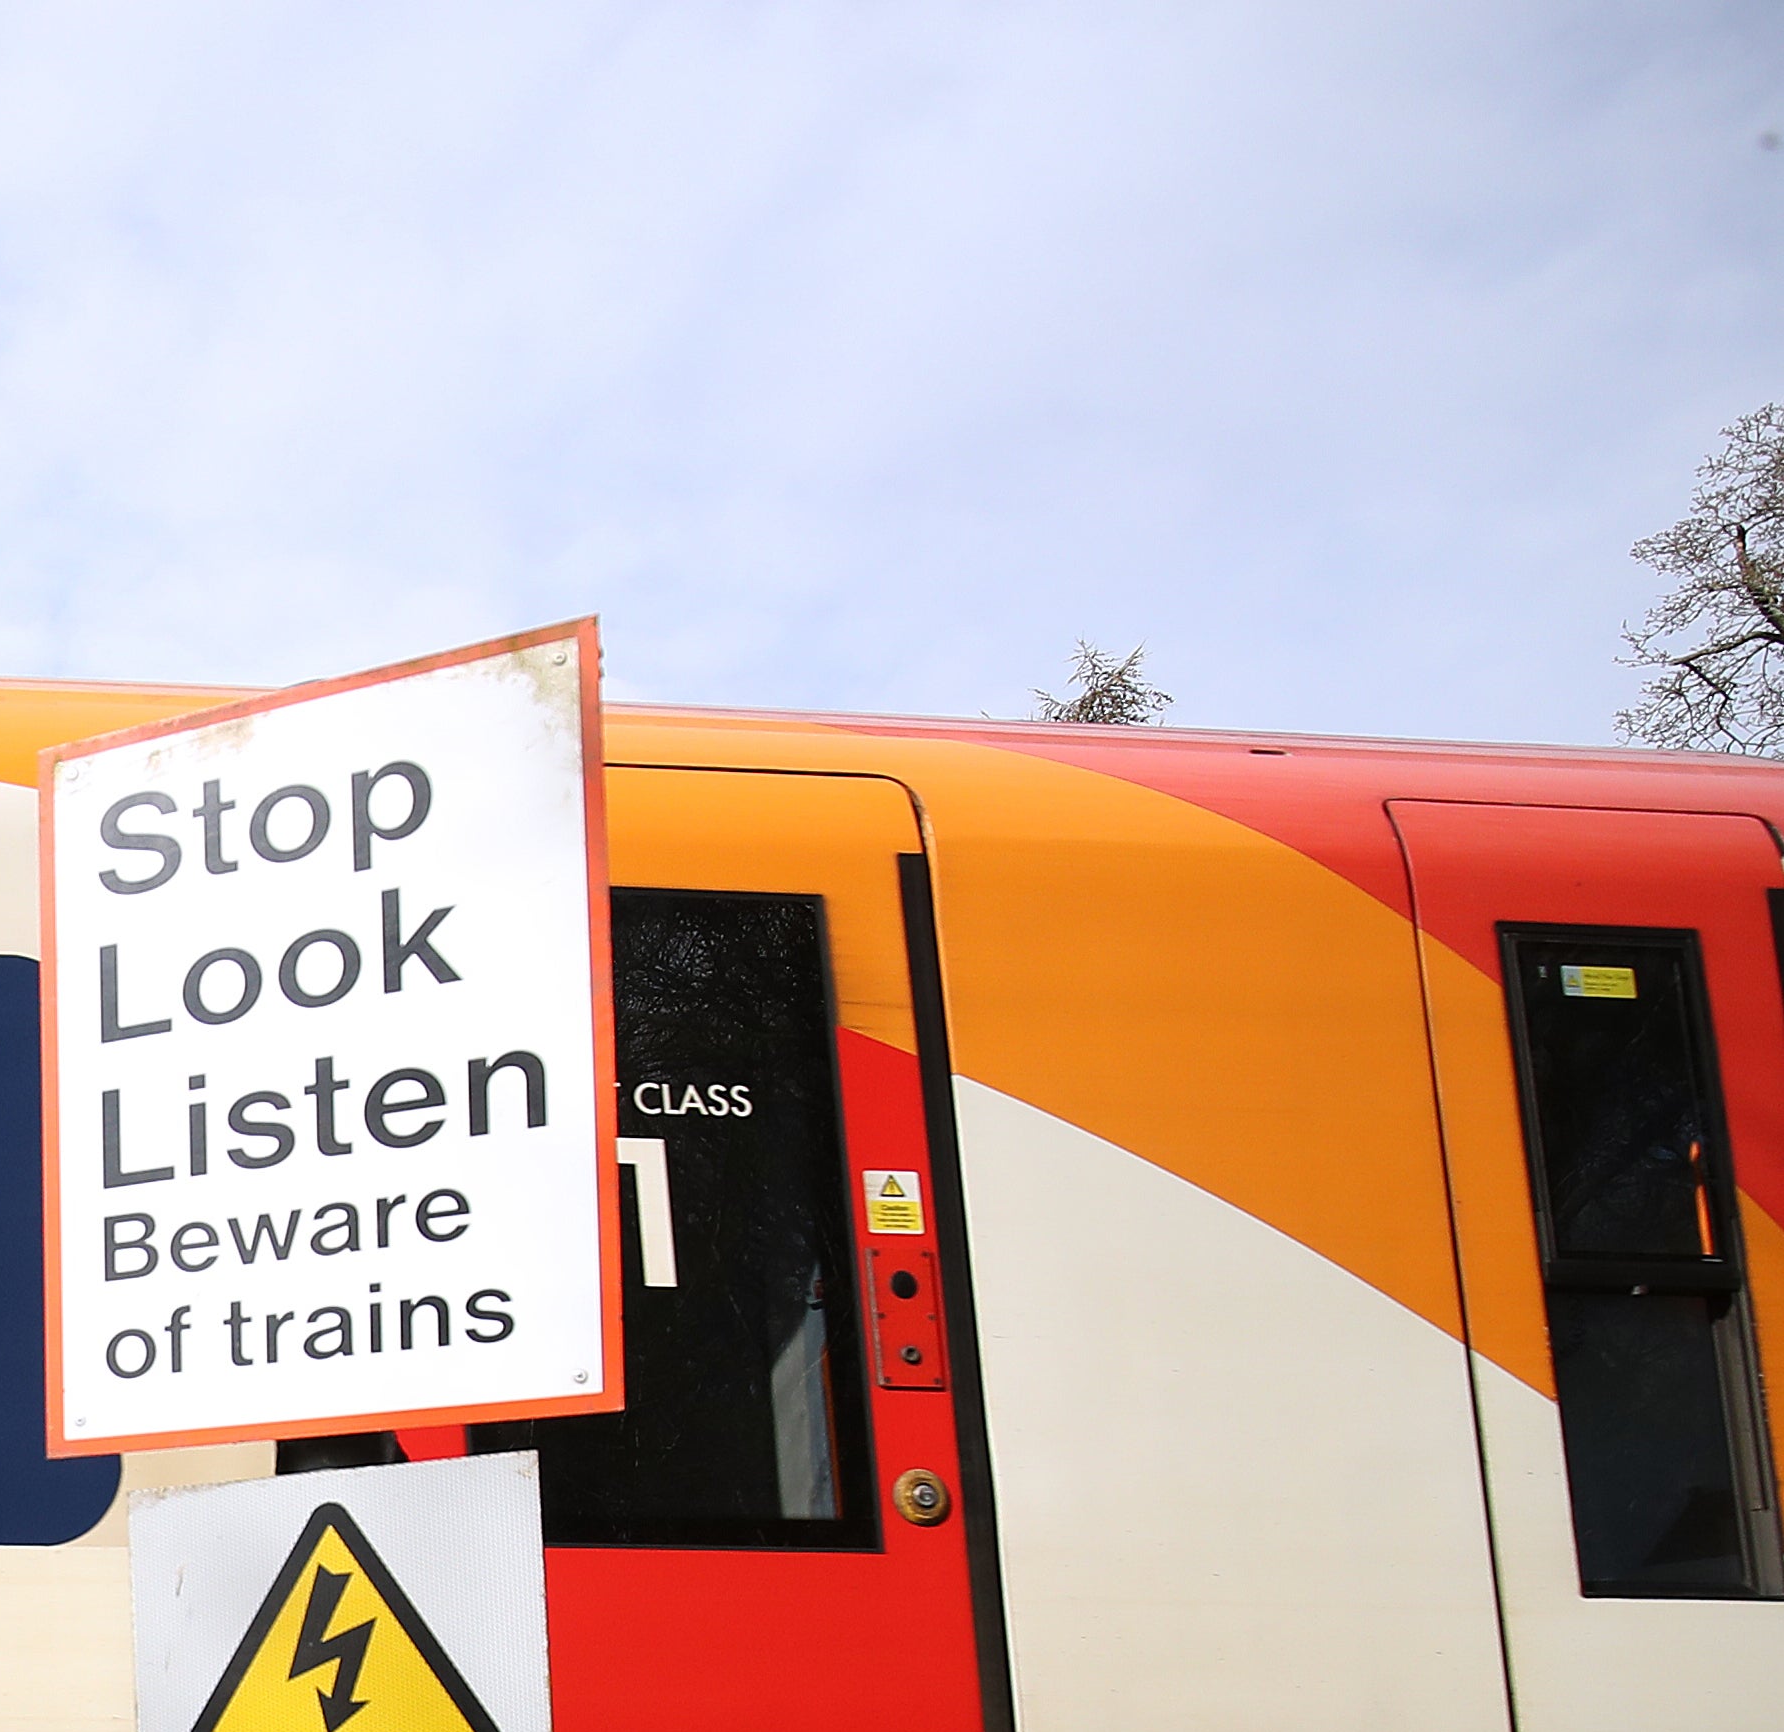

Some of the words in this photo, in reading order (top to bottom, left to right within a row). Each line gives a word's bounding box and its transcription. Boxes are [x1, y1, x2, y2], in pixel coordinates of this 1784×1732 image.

[97, 760, 433, 895] Stop
[98, 887, 463, 1044] Look
[101, 1049, 548, 1190] Listen
[632, 1081, 754, 1118] CLASS
[103, 1187, 471, 1283] Beware
[105, 1304, 192, 1380] of
[222, 1281, 516, 1368] trains
